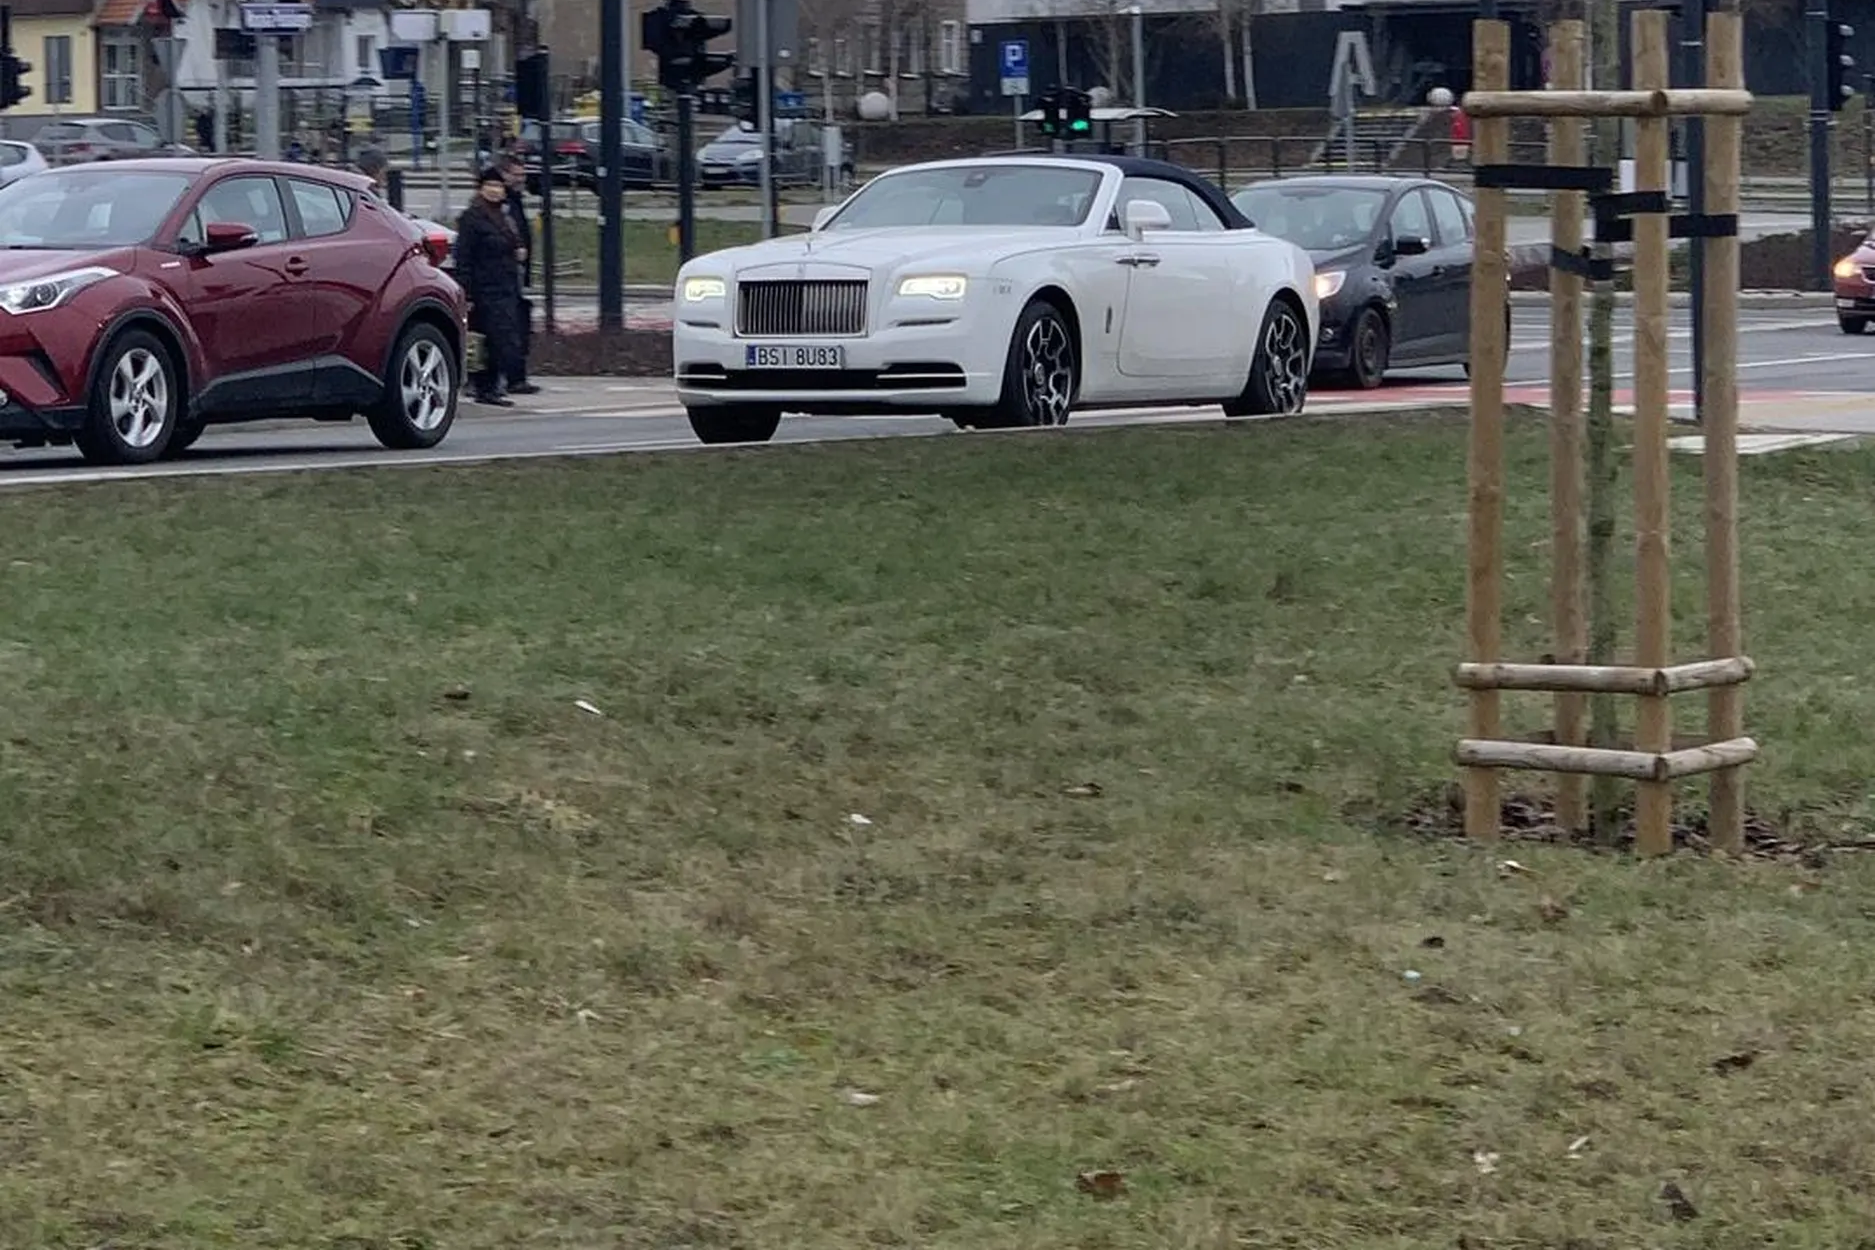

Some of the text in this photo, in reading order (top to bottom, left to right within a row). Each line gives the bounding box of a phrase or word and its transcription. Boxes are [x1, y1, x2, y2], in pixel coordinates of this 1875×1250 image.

[1005, 44, 1023, 67] P
[1328, 31, 1376, 97] A
[796, 348, 837, 365] 8U83
